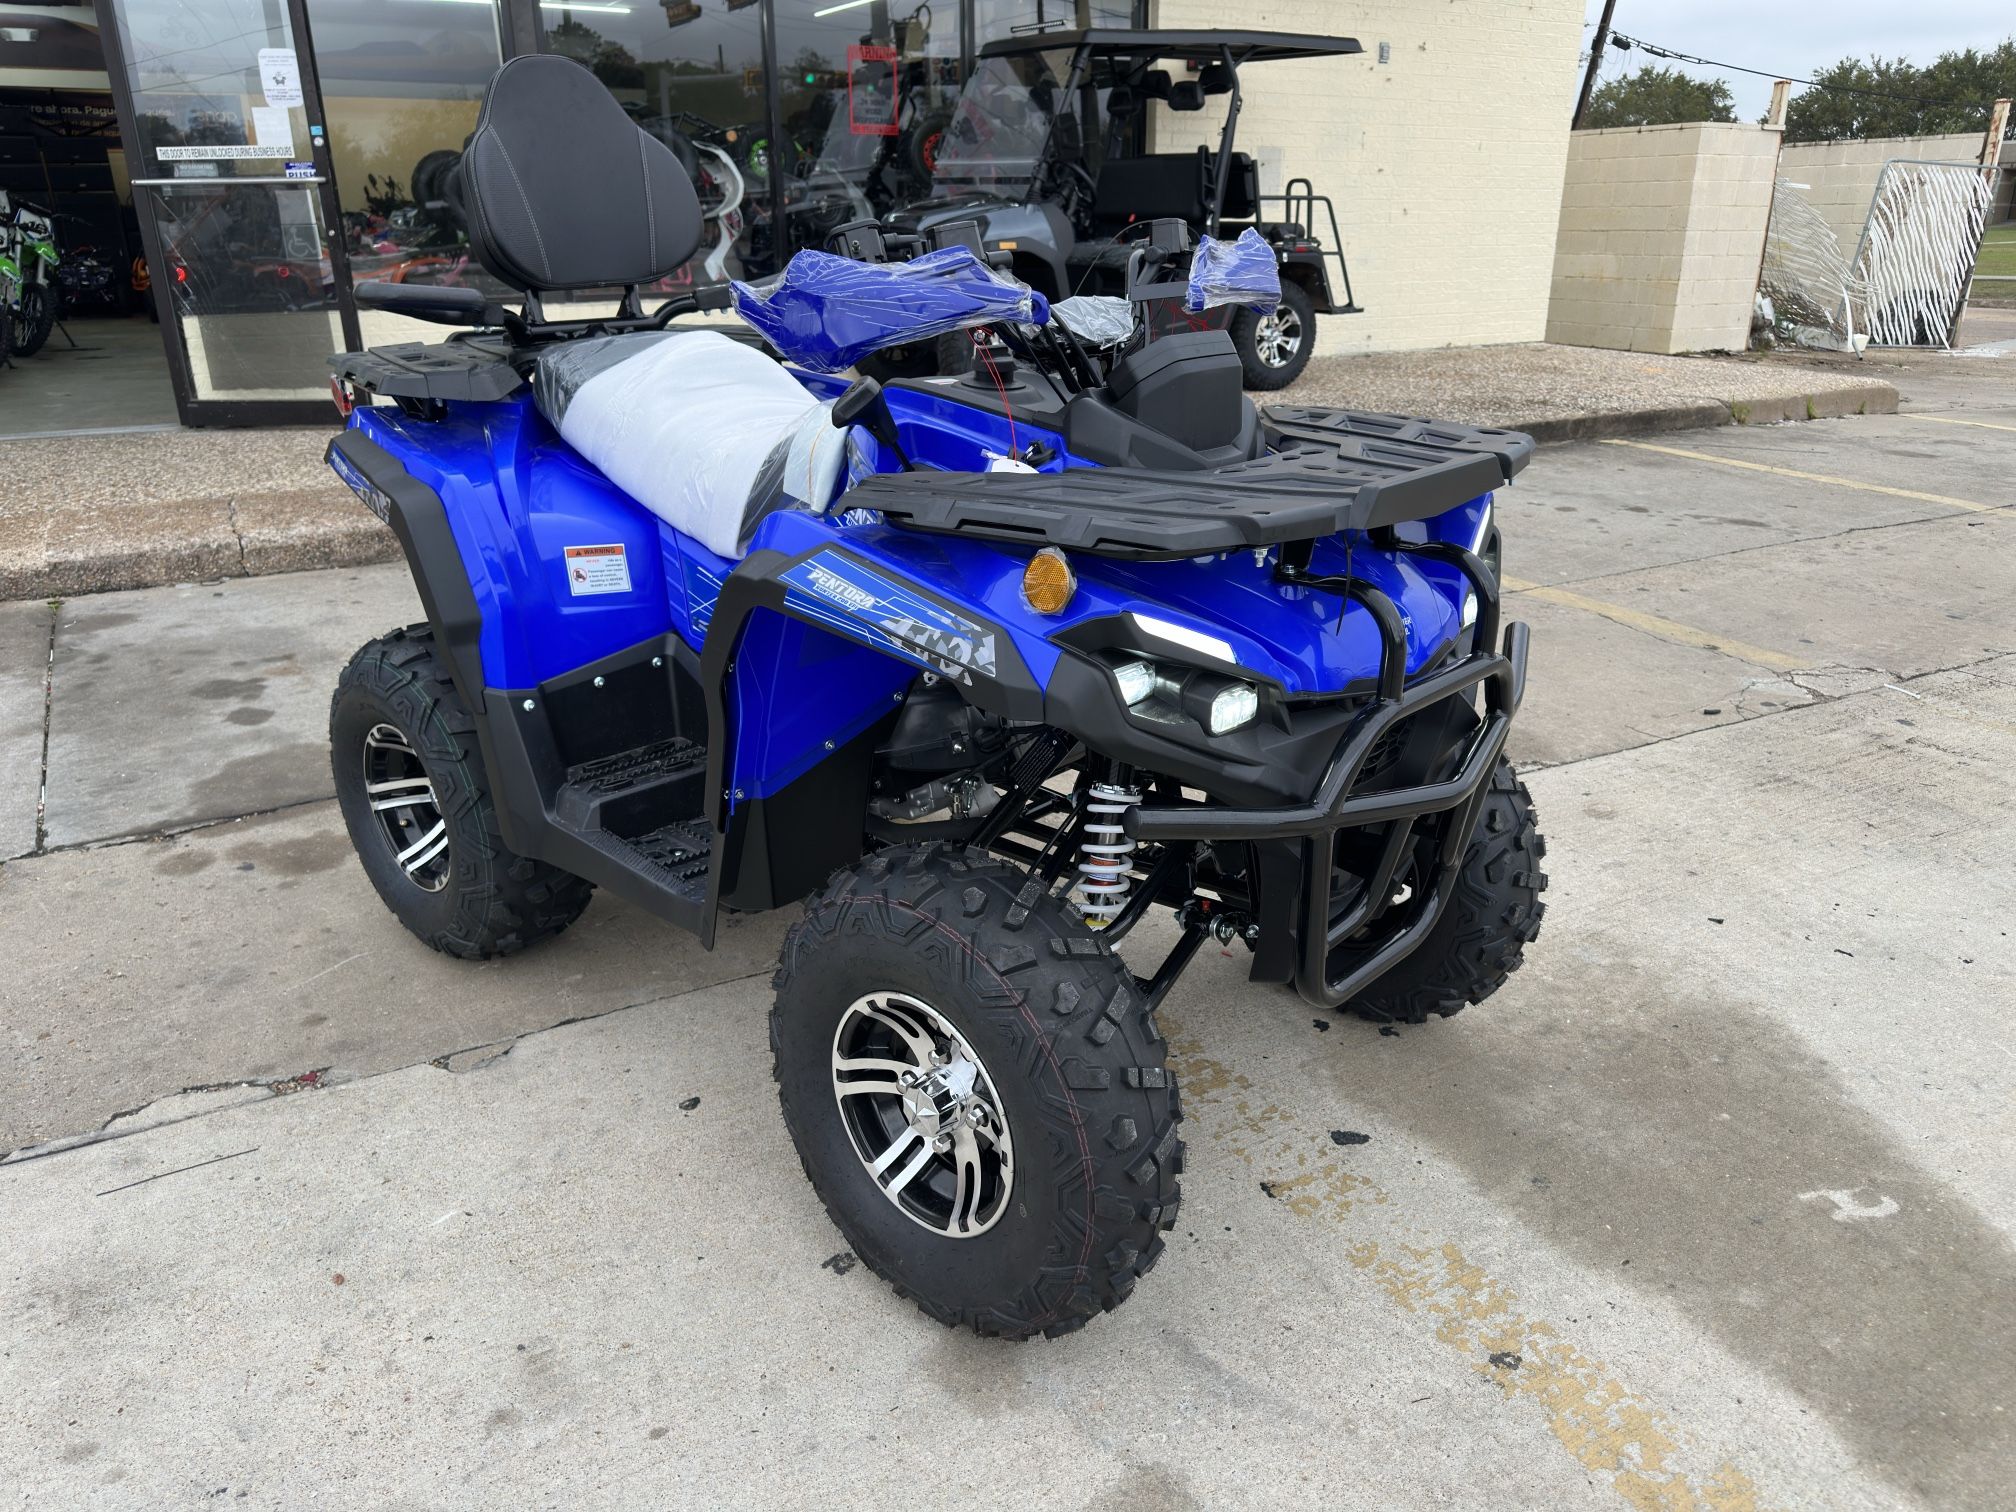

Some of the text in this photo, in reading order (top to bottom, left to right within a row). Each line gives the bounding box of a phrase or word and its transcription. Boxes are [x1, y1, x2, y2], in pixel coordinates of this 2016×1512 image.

[159, 146, 292, 158] THIS DOOR TO REMAIN UNLOCKED DURING BUSINESS HOURS
[584, 547, 616, 555] WARNING
